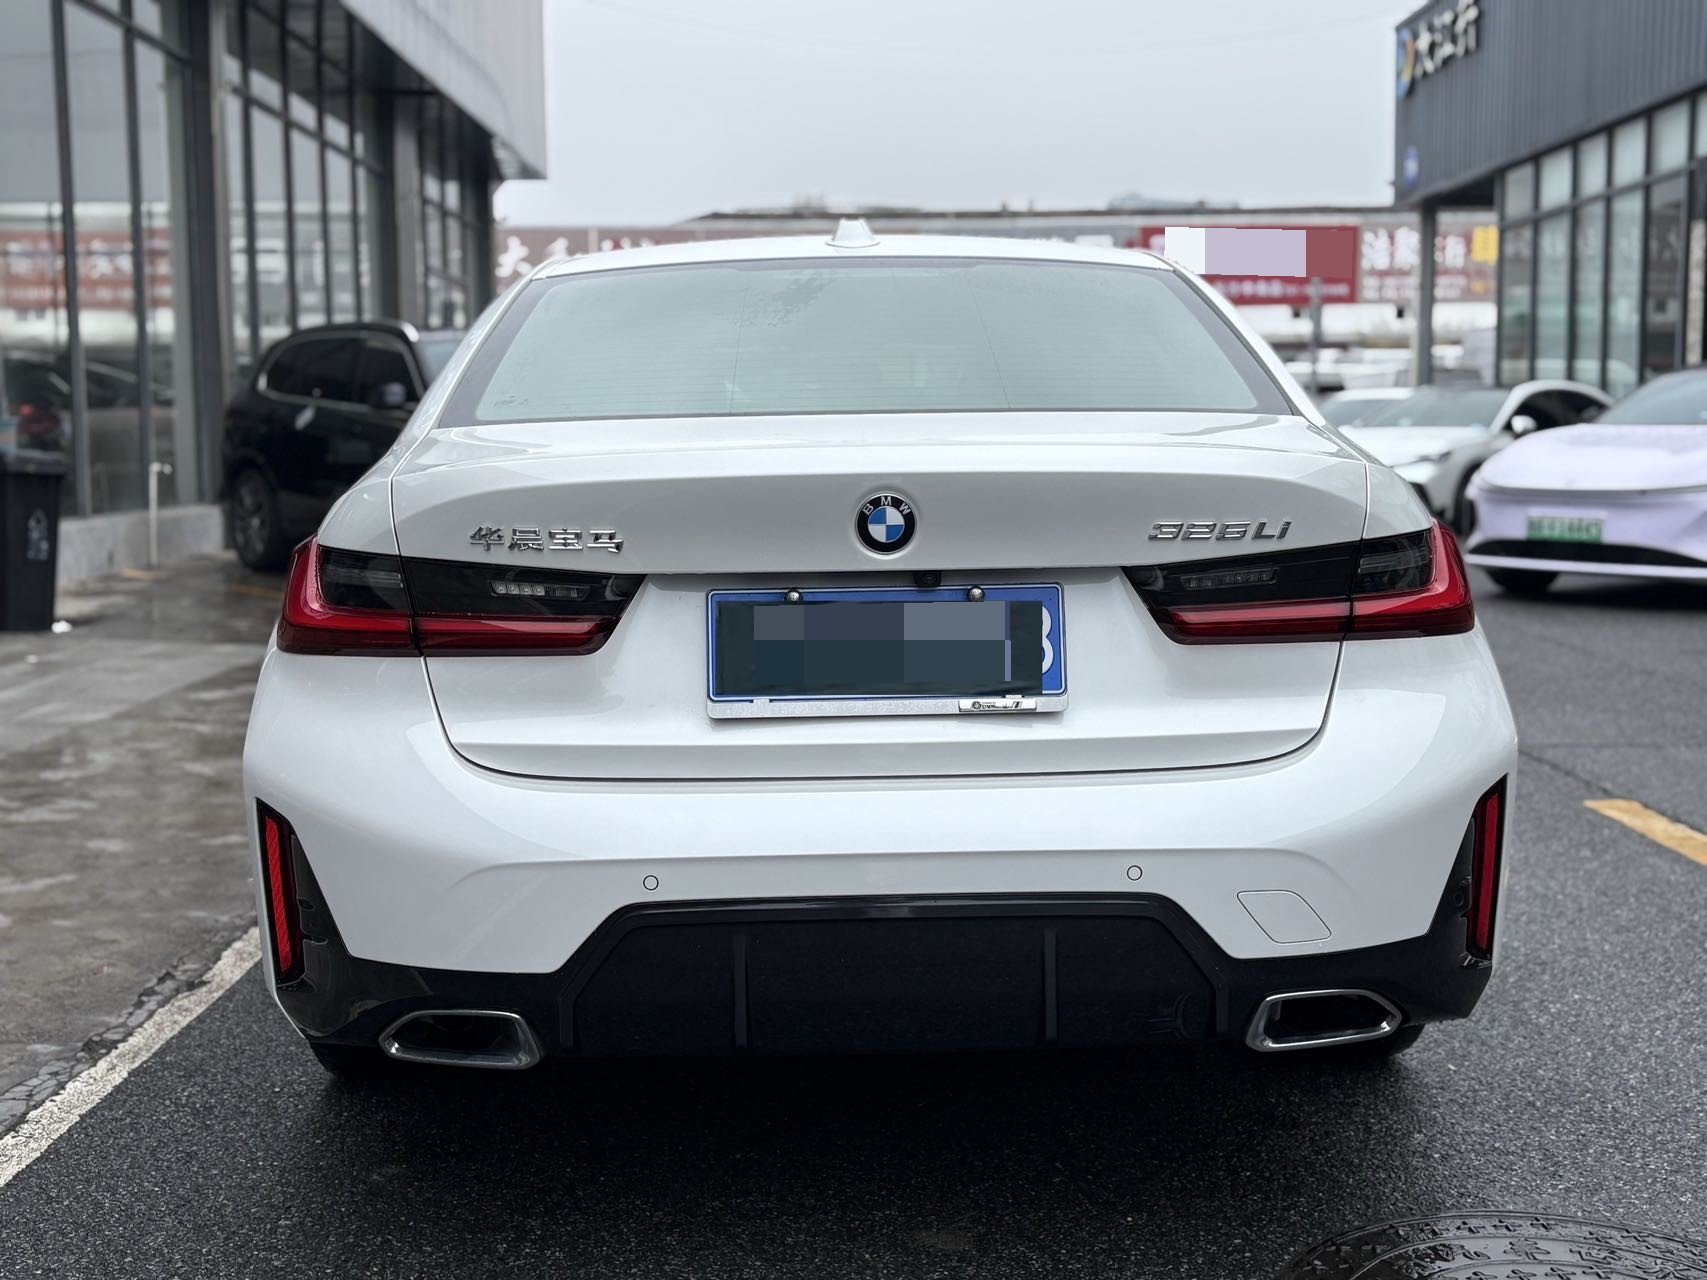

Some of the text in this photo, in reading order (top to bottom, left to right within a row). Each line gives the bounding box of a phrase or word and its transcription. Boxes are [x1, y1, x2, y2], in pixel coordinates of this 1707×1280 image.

[862, 496, 911, 516] BMW
[469, 526, 625, 553] 华晨宝马
[1148, 521, 1292, 541] 325Li
